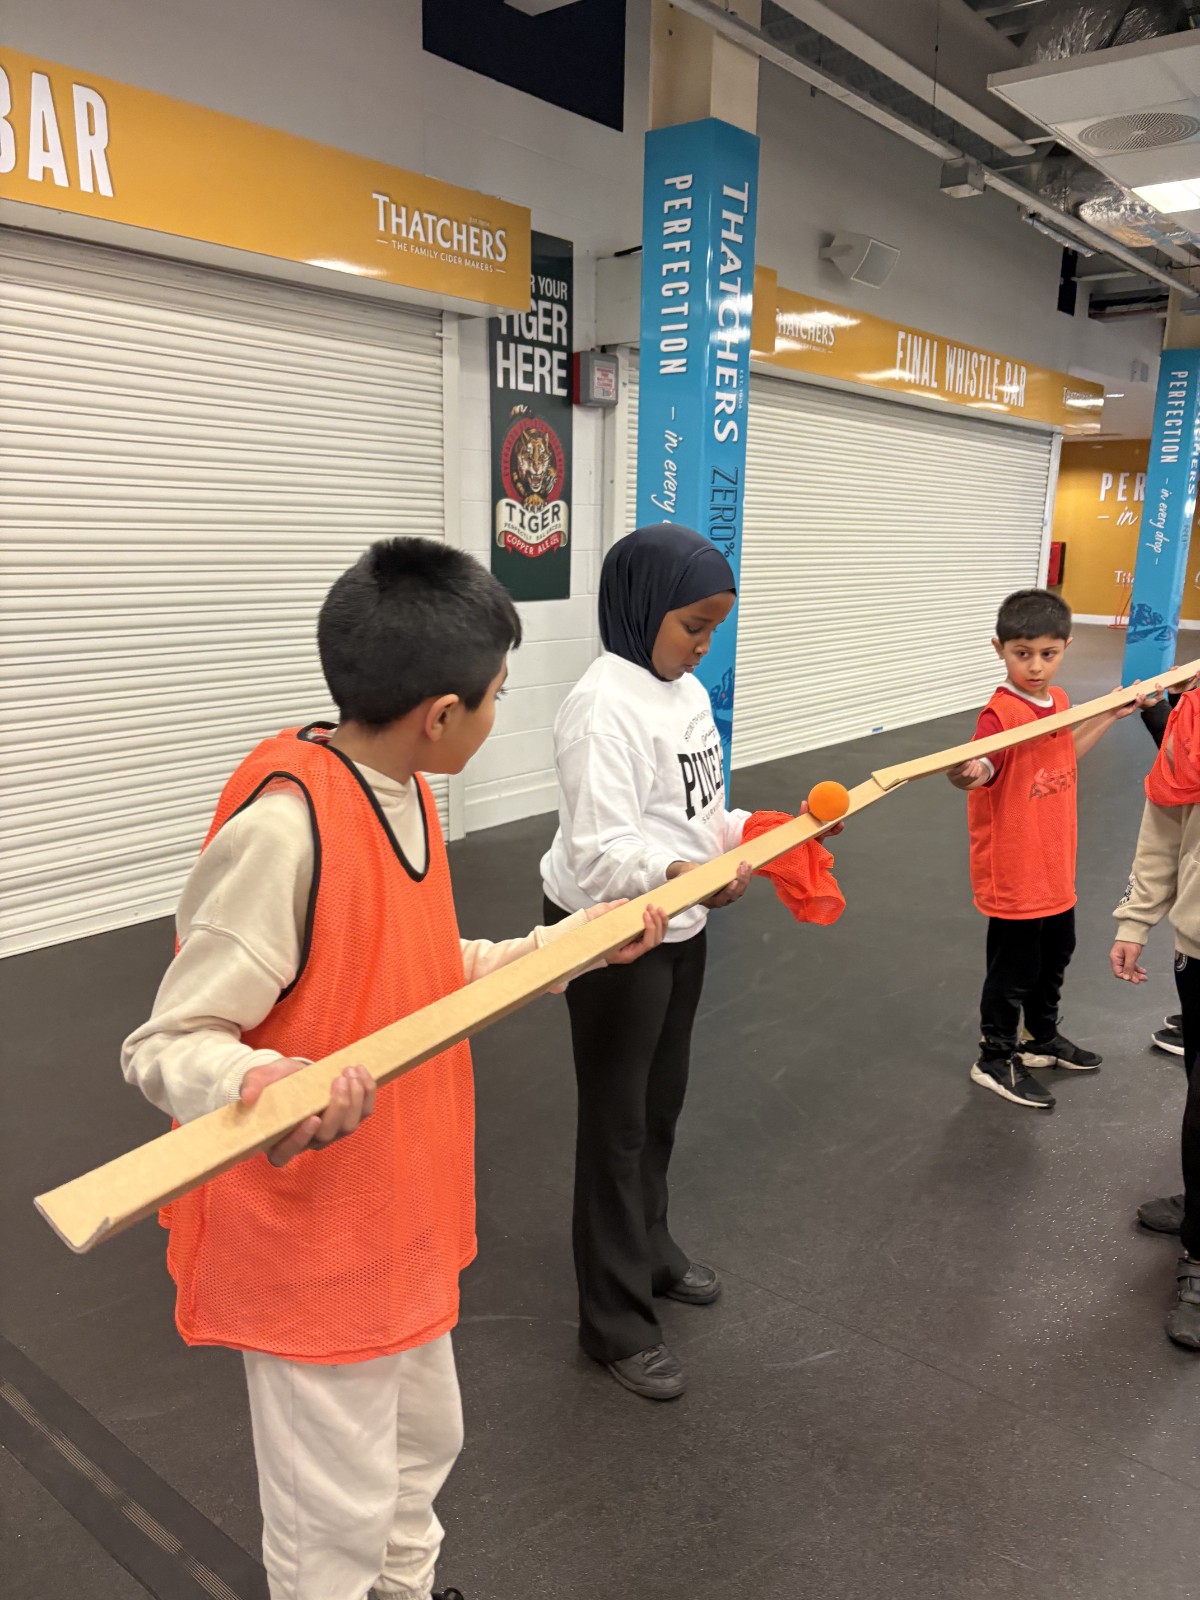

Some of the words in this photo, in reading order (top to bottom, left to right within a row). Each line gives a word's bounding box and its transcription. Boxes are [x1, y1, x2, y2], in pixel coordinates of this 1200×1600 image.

[372, 192, 507, 263] THATCHERS
[392, 240, 408, 252] THE
[410, 245, 439, 259] FAMILY
[440, 252, 463, 265] CIDER
[464, 258, 494, 273] MAKERS
[538, 275, 568, 301] YOUR
[659, 174, 693, 375] PERFECTION
[714, 181, 749, 443] THATCHERS
[776, 308, 835, 346] HATCHERS
[496, 340, 568, 397] HERE
[895, 330, 938, 388] FINAL
[945, 344, 1001, 401] WHISTLE
[1003, 361, 1027, 408] BAR
[1160, 370, 1189, 463] PERFECTION
[664, 430, 683, 454] in
[651, 459, 678, 513] every
[1160, 488, 1172, 500] in
[504, 502, 561, 534] TIGER
[1116, 505, 1138, 526] in
[1149, 502, 1168, 529] every
[506, 533, 534, 555] COPPER
[537, 540, 550, 554] ALE
[1145, 530, 1170, 553] drop
